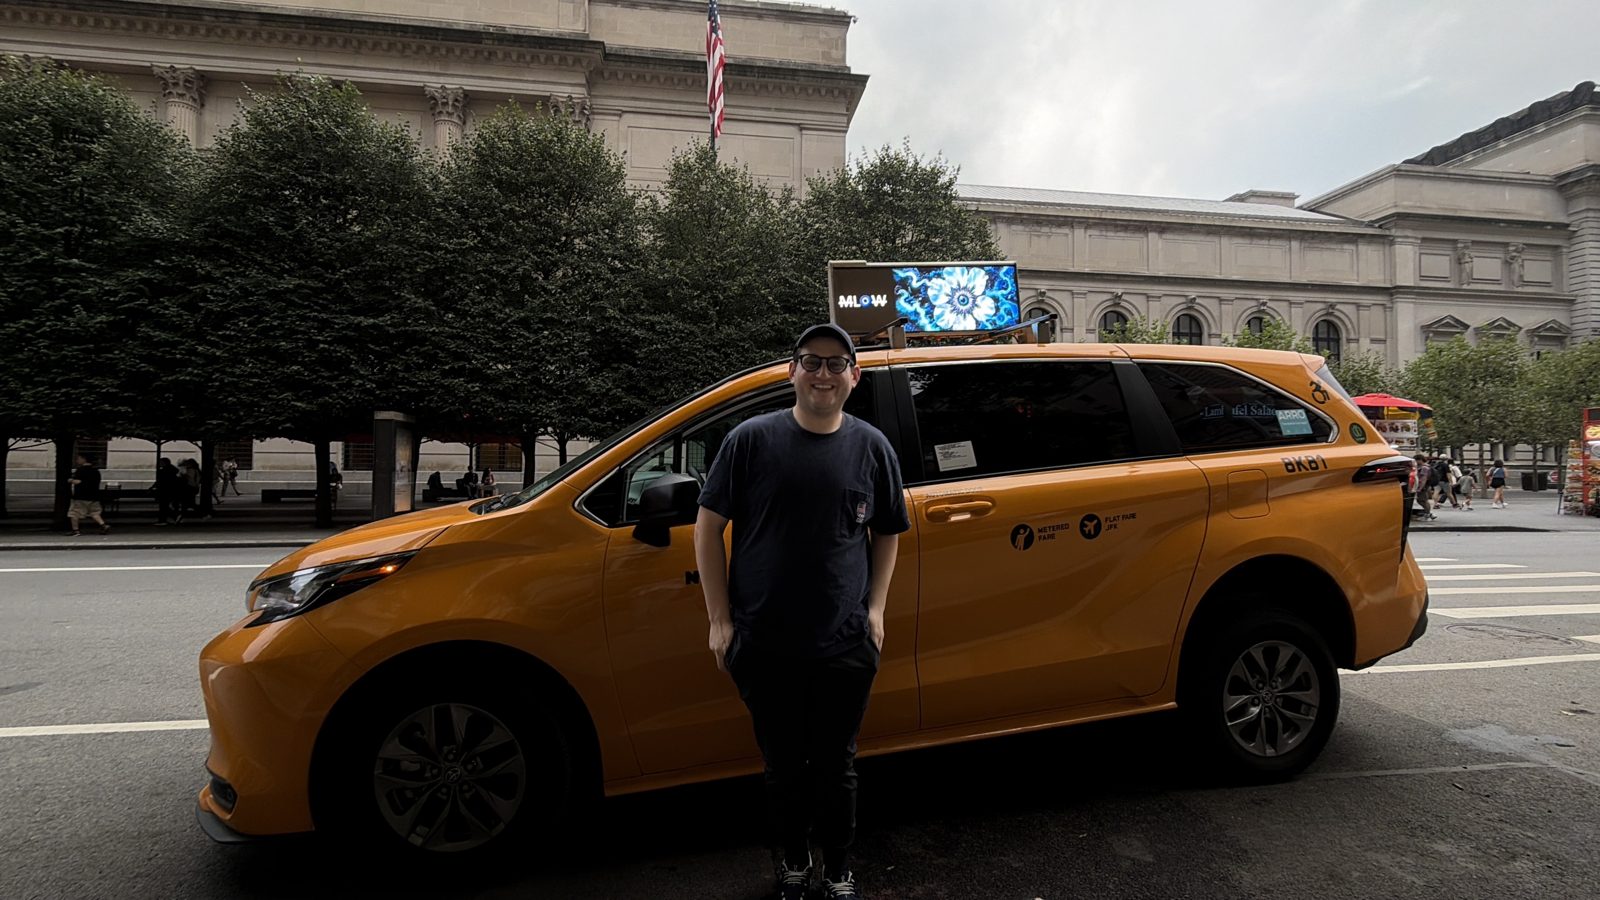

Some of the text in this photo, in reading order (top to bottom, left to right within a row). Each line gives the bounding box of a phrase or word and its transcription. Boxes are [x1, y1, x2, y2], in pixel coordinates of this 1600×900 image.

[838, 294, 888, 308] MLOW
[1278, 410, 1305, 420] ARRO
[1105, 513, 1137, 523] FLAT FARE
[1037, 523, 1069, 534] METERED
[1105, 523, 1118, 531] JFK
[1038, 533, 1056, 542] FARE
